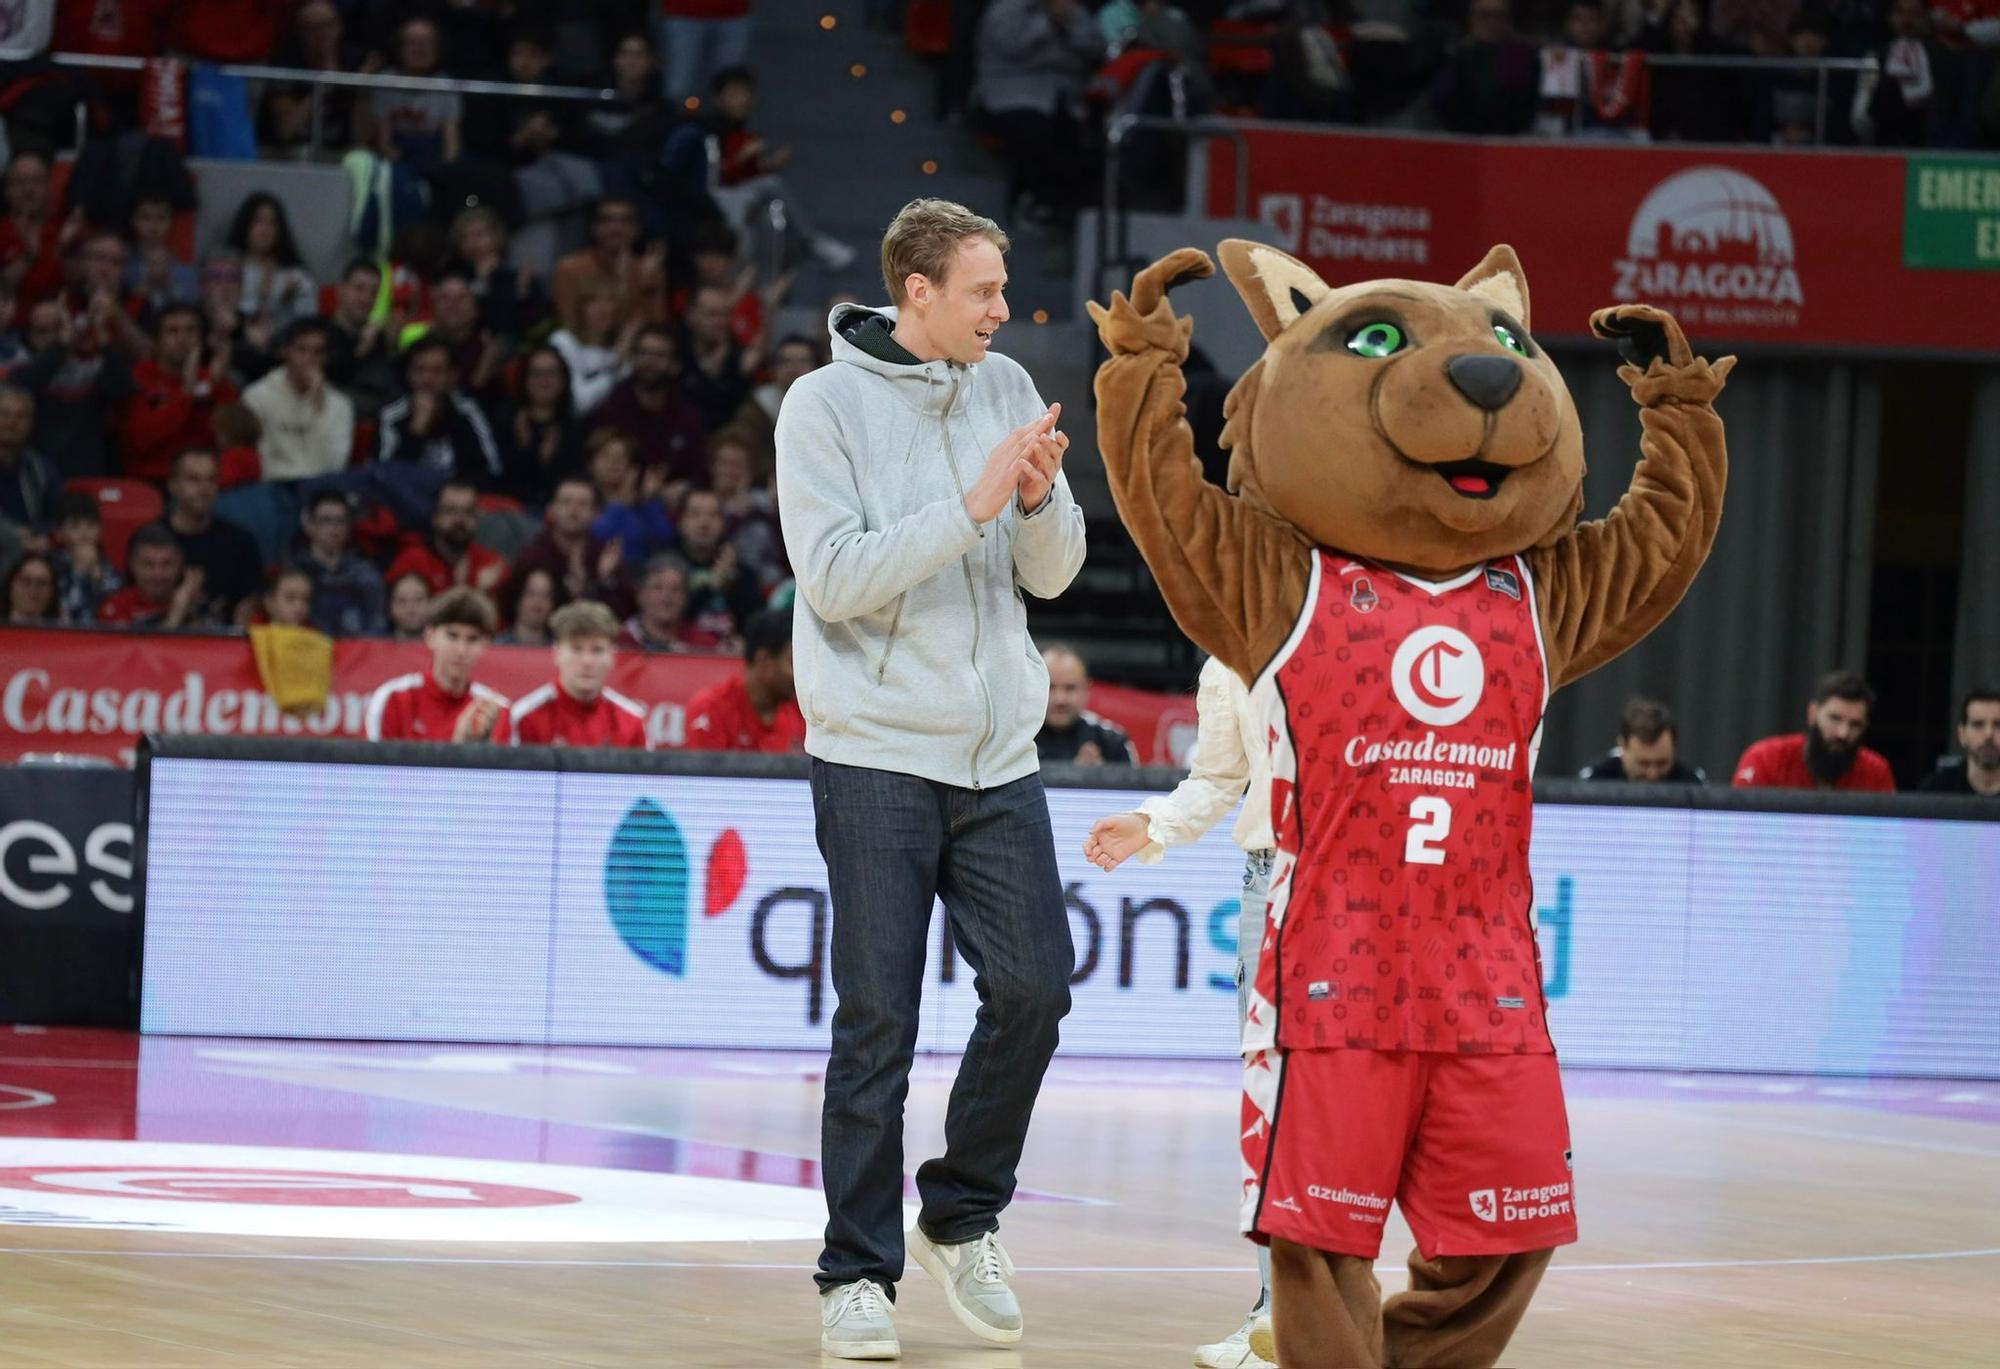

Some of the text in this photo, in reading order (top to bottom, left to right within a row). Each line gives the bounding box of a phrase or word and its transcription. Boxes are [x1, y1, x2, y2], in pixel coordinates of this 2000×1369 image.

[1614, 260, 1803, 305] ZARAGOZA
[1344, 731, 1516, 771] Casademont
[1389, 767, 1475, 789] ZARAGOZA
[1405, 795, 1452, 865] 2
[1307, 1184, 1388, 1210] azulmarino
